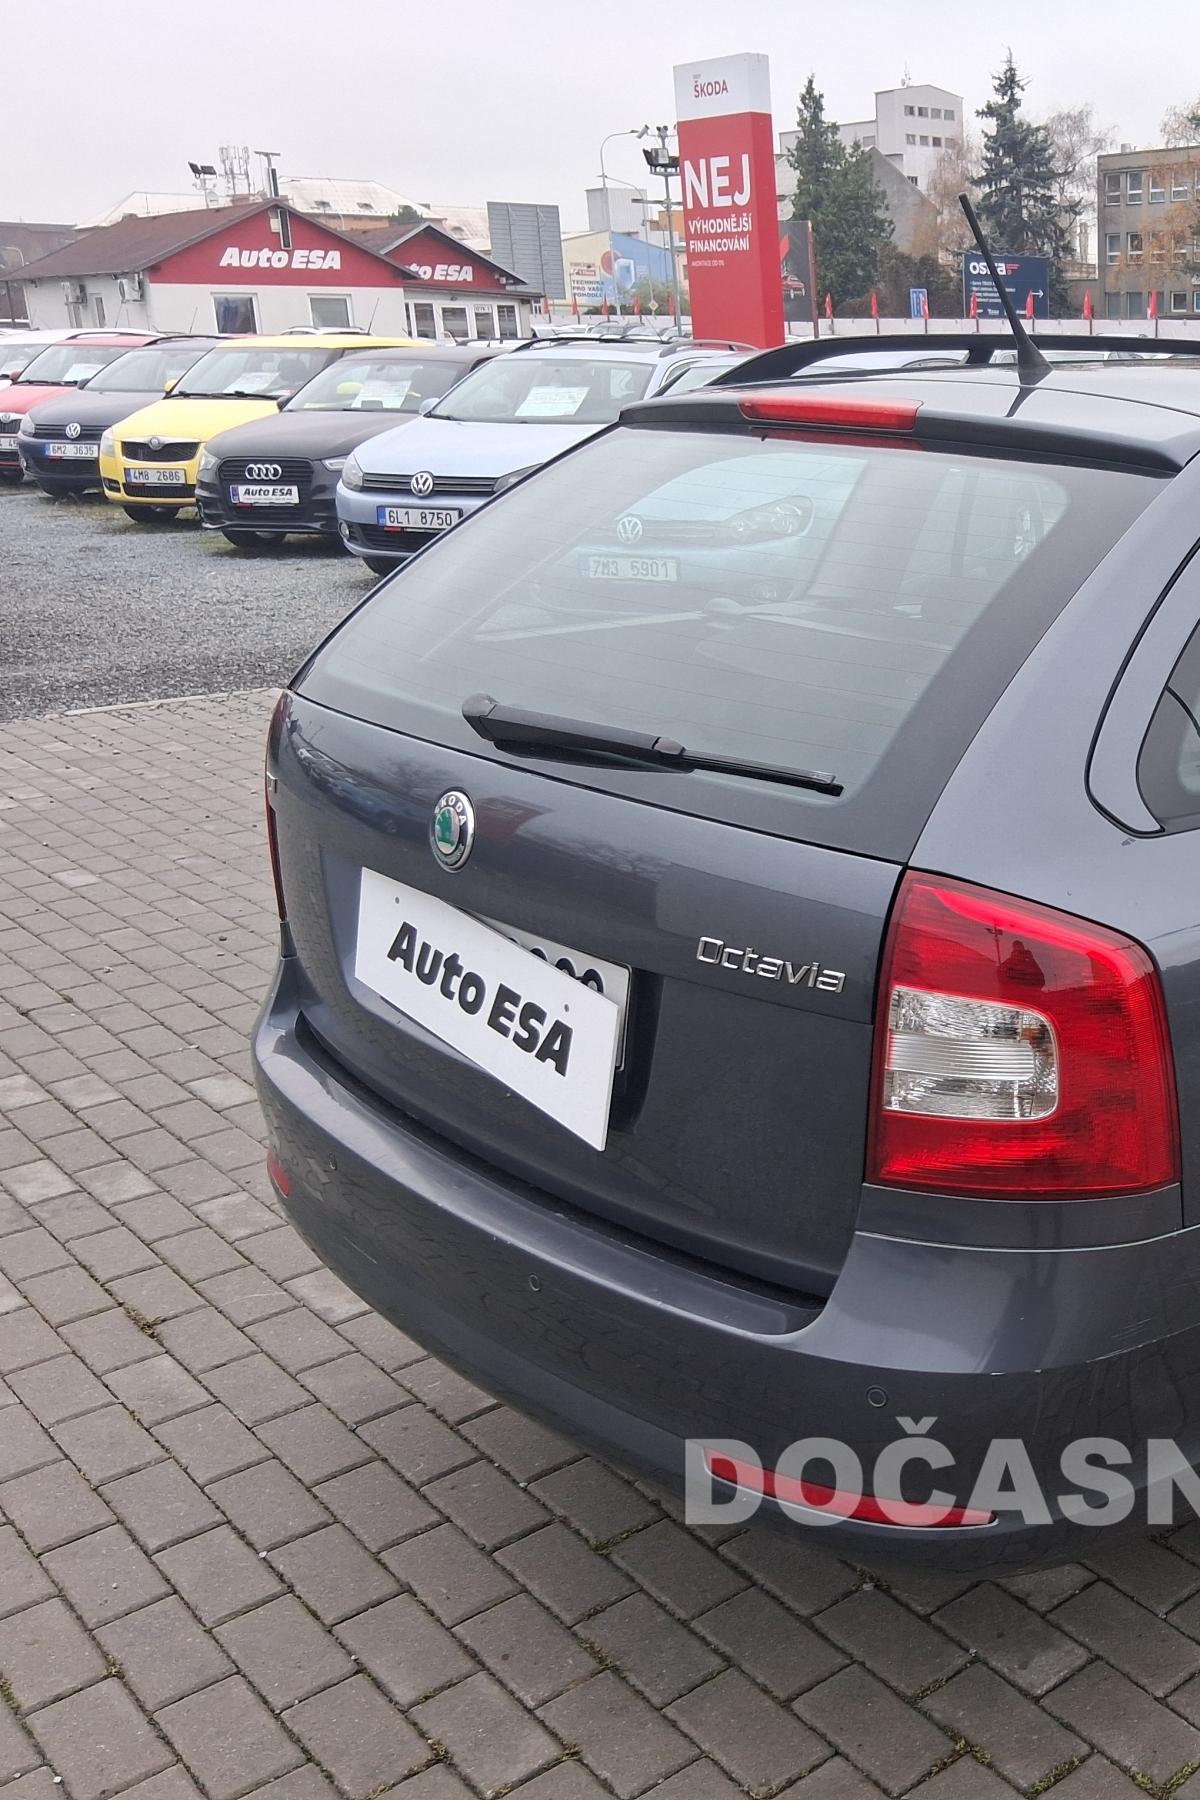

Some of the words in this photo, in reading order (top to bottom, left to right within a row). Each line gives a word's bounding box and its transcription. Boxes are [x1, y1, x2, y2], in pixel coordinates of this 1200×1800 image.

[693, 79, 729, 99] ŠKODA
[684, 153, 751, 209] NEJ
[688, 213, 752, 234] VÝHODNĚJŠÍ
[689, 235, 750, 253] FINANCOVÁNÍ
[219, 246, 289, 269] Auto
[291, 249, 341, 270] ESA
[433, 263, 474, 282] ESA
[243, 487, 270, 496] Auto
[271, 488, 293, 496] ESA
[388, 510, 411, 525] 6L1
[420, 511, 453, 526] 8750
[696, 936, 846, 993] Octavia
[386, 920, 486, 1016] Auto
[487, 982, 573, 1078] ESA
